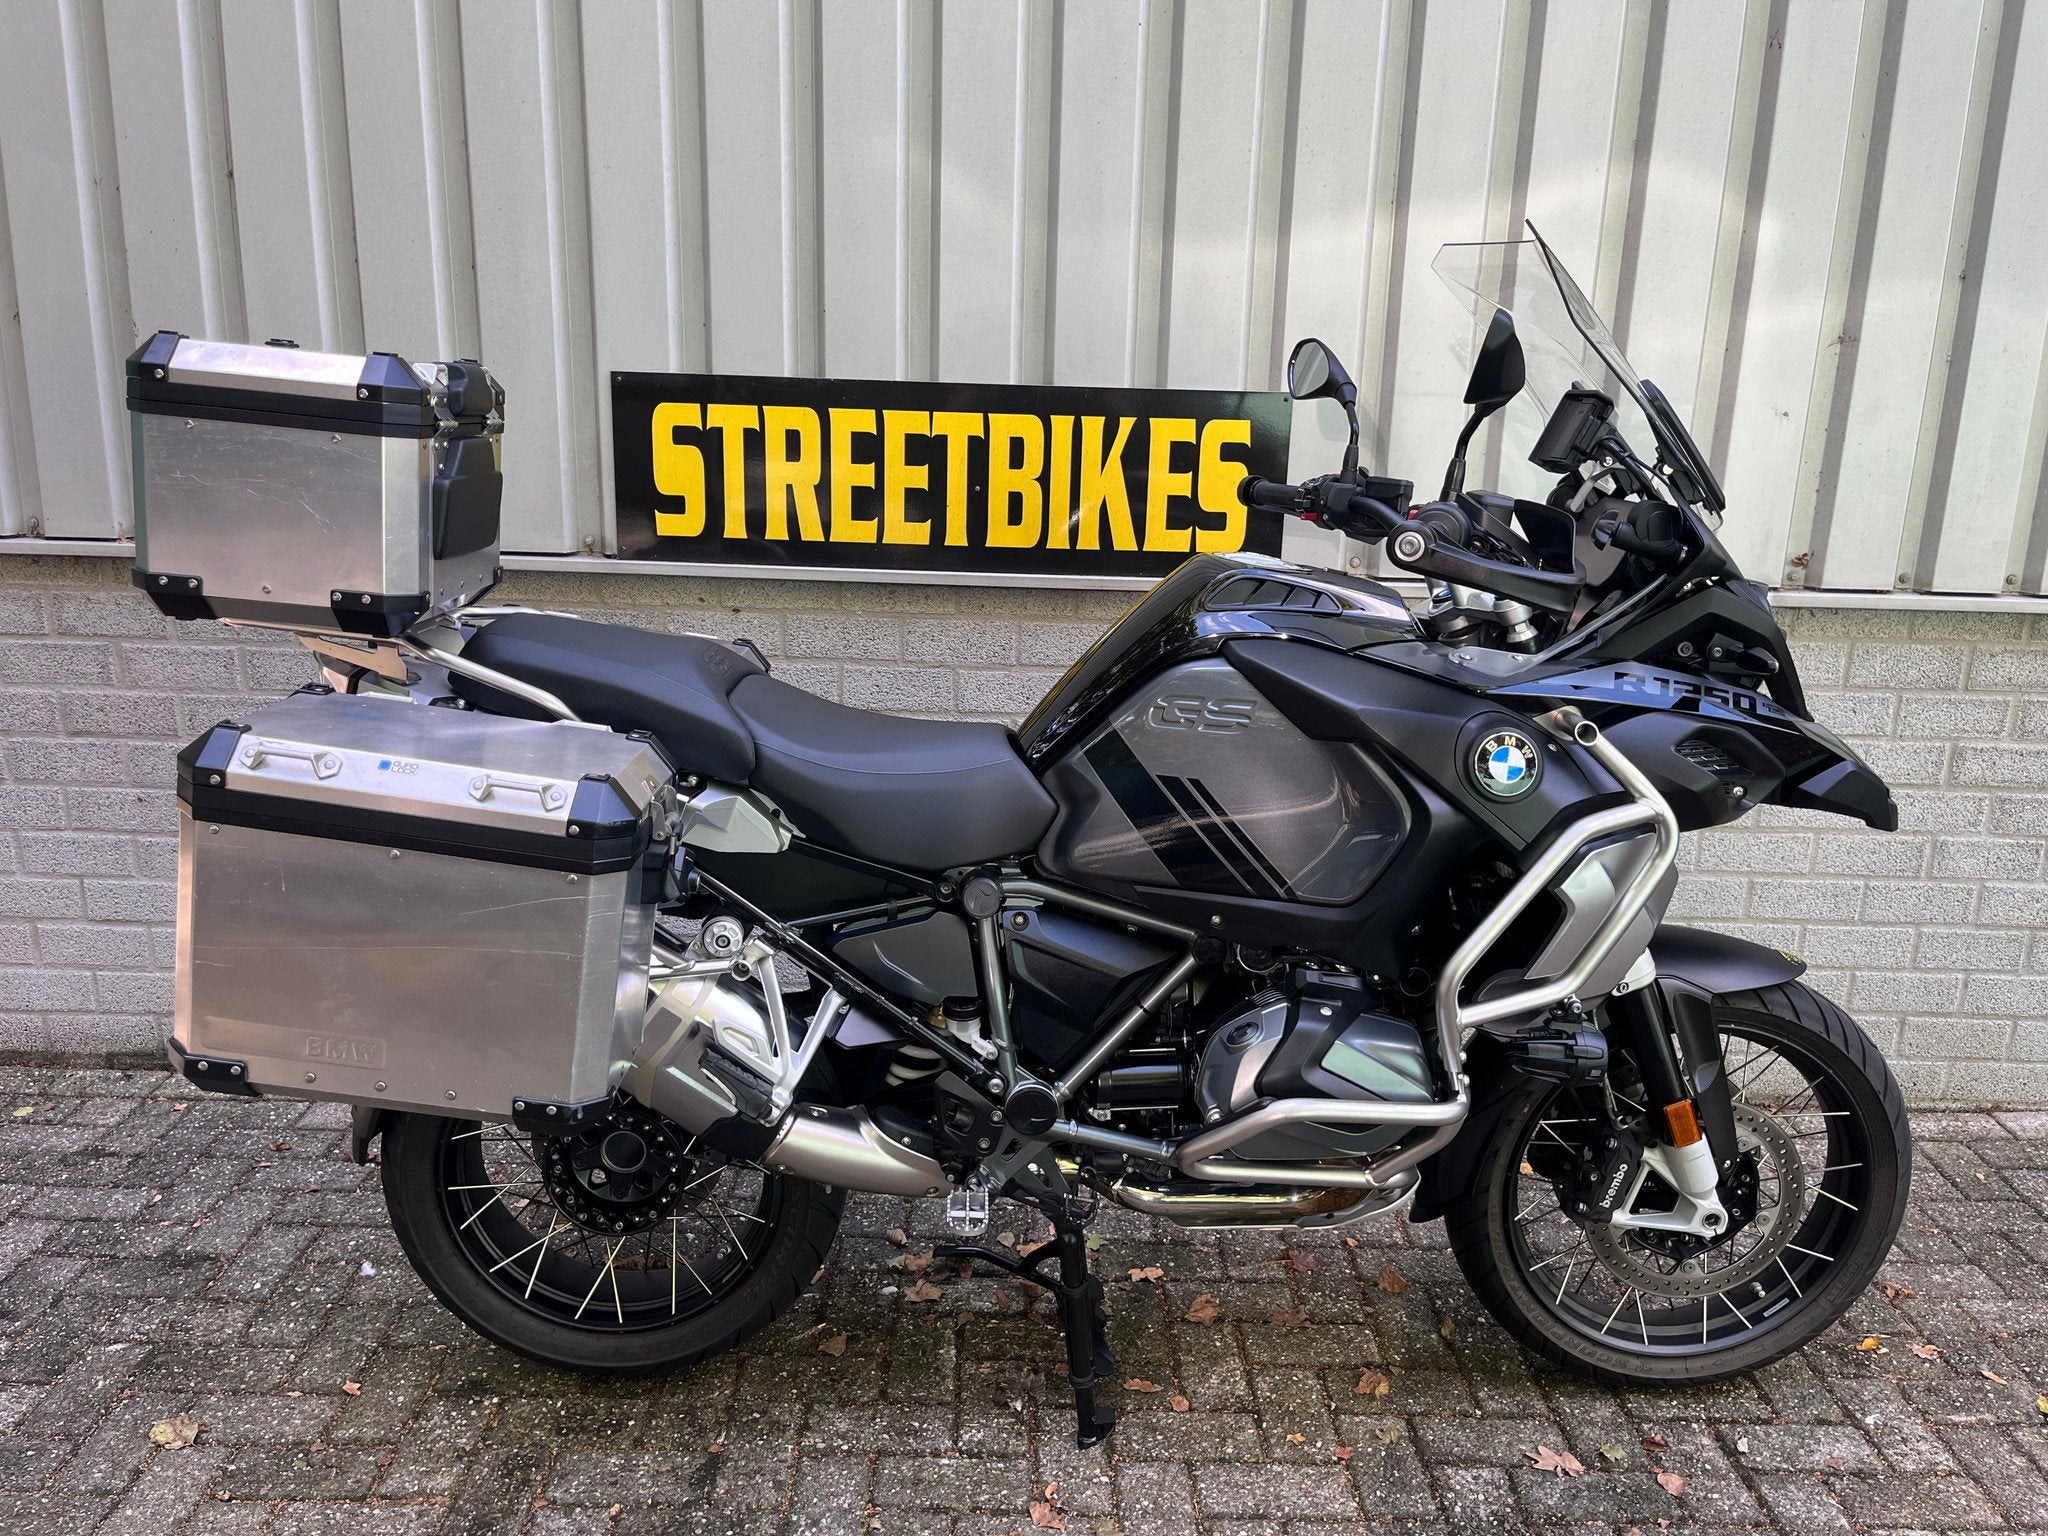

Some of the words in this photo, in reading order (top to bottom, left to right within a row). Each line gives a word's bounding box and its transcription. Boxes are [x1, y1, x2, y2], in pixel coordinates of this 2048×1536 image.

[651, 402, 1251, 553] STREETBIKES
[1148, 694, 1257, 735] GS
[1485, 736, 1534, 759] BMW
[306, 1036, 378, 1064] BMW
[1599, 1163, 1629, 1208] brembo
